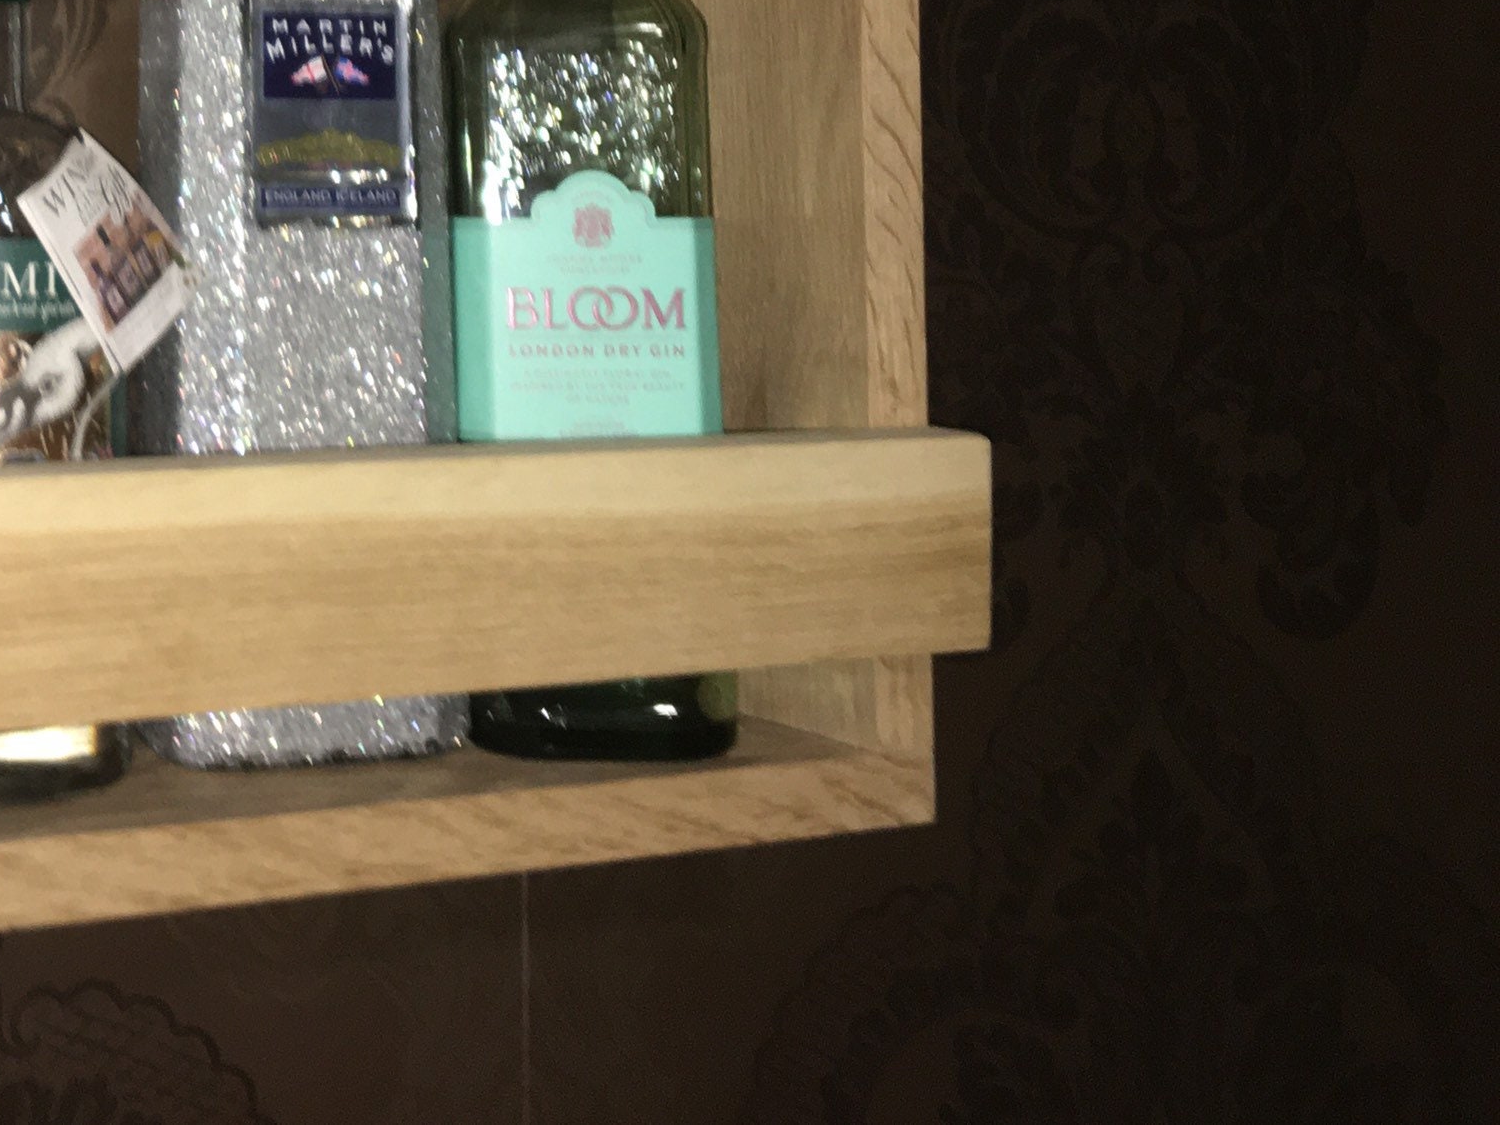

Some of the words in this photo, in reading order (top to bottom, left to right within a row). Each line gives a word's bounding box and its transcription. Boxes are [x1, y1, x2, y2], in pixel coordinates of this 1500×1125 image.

[271, 17, 388, 36] MARTIN
[265, 34, 394, 65] MILLER'S
[506, 285, 687, 331] BLOOM
[508, 342, 595, 358] LONDON
[603, 342, 643, 358] DRY
[649, 342, 686, 359] GIN
